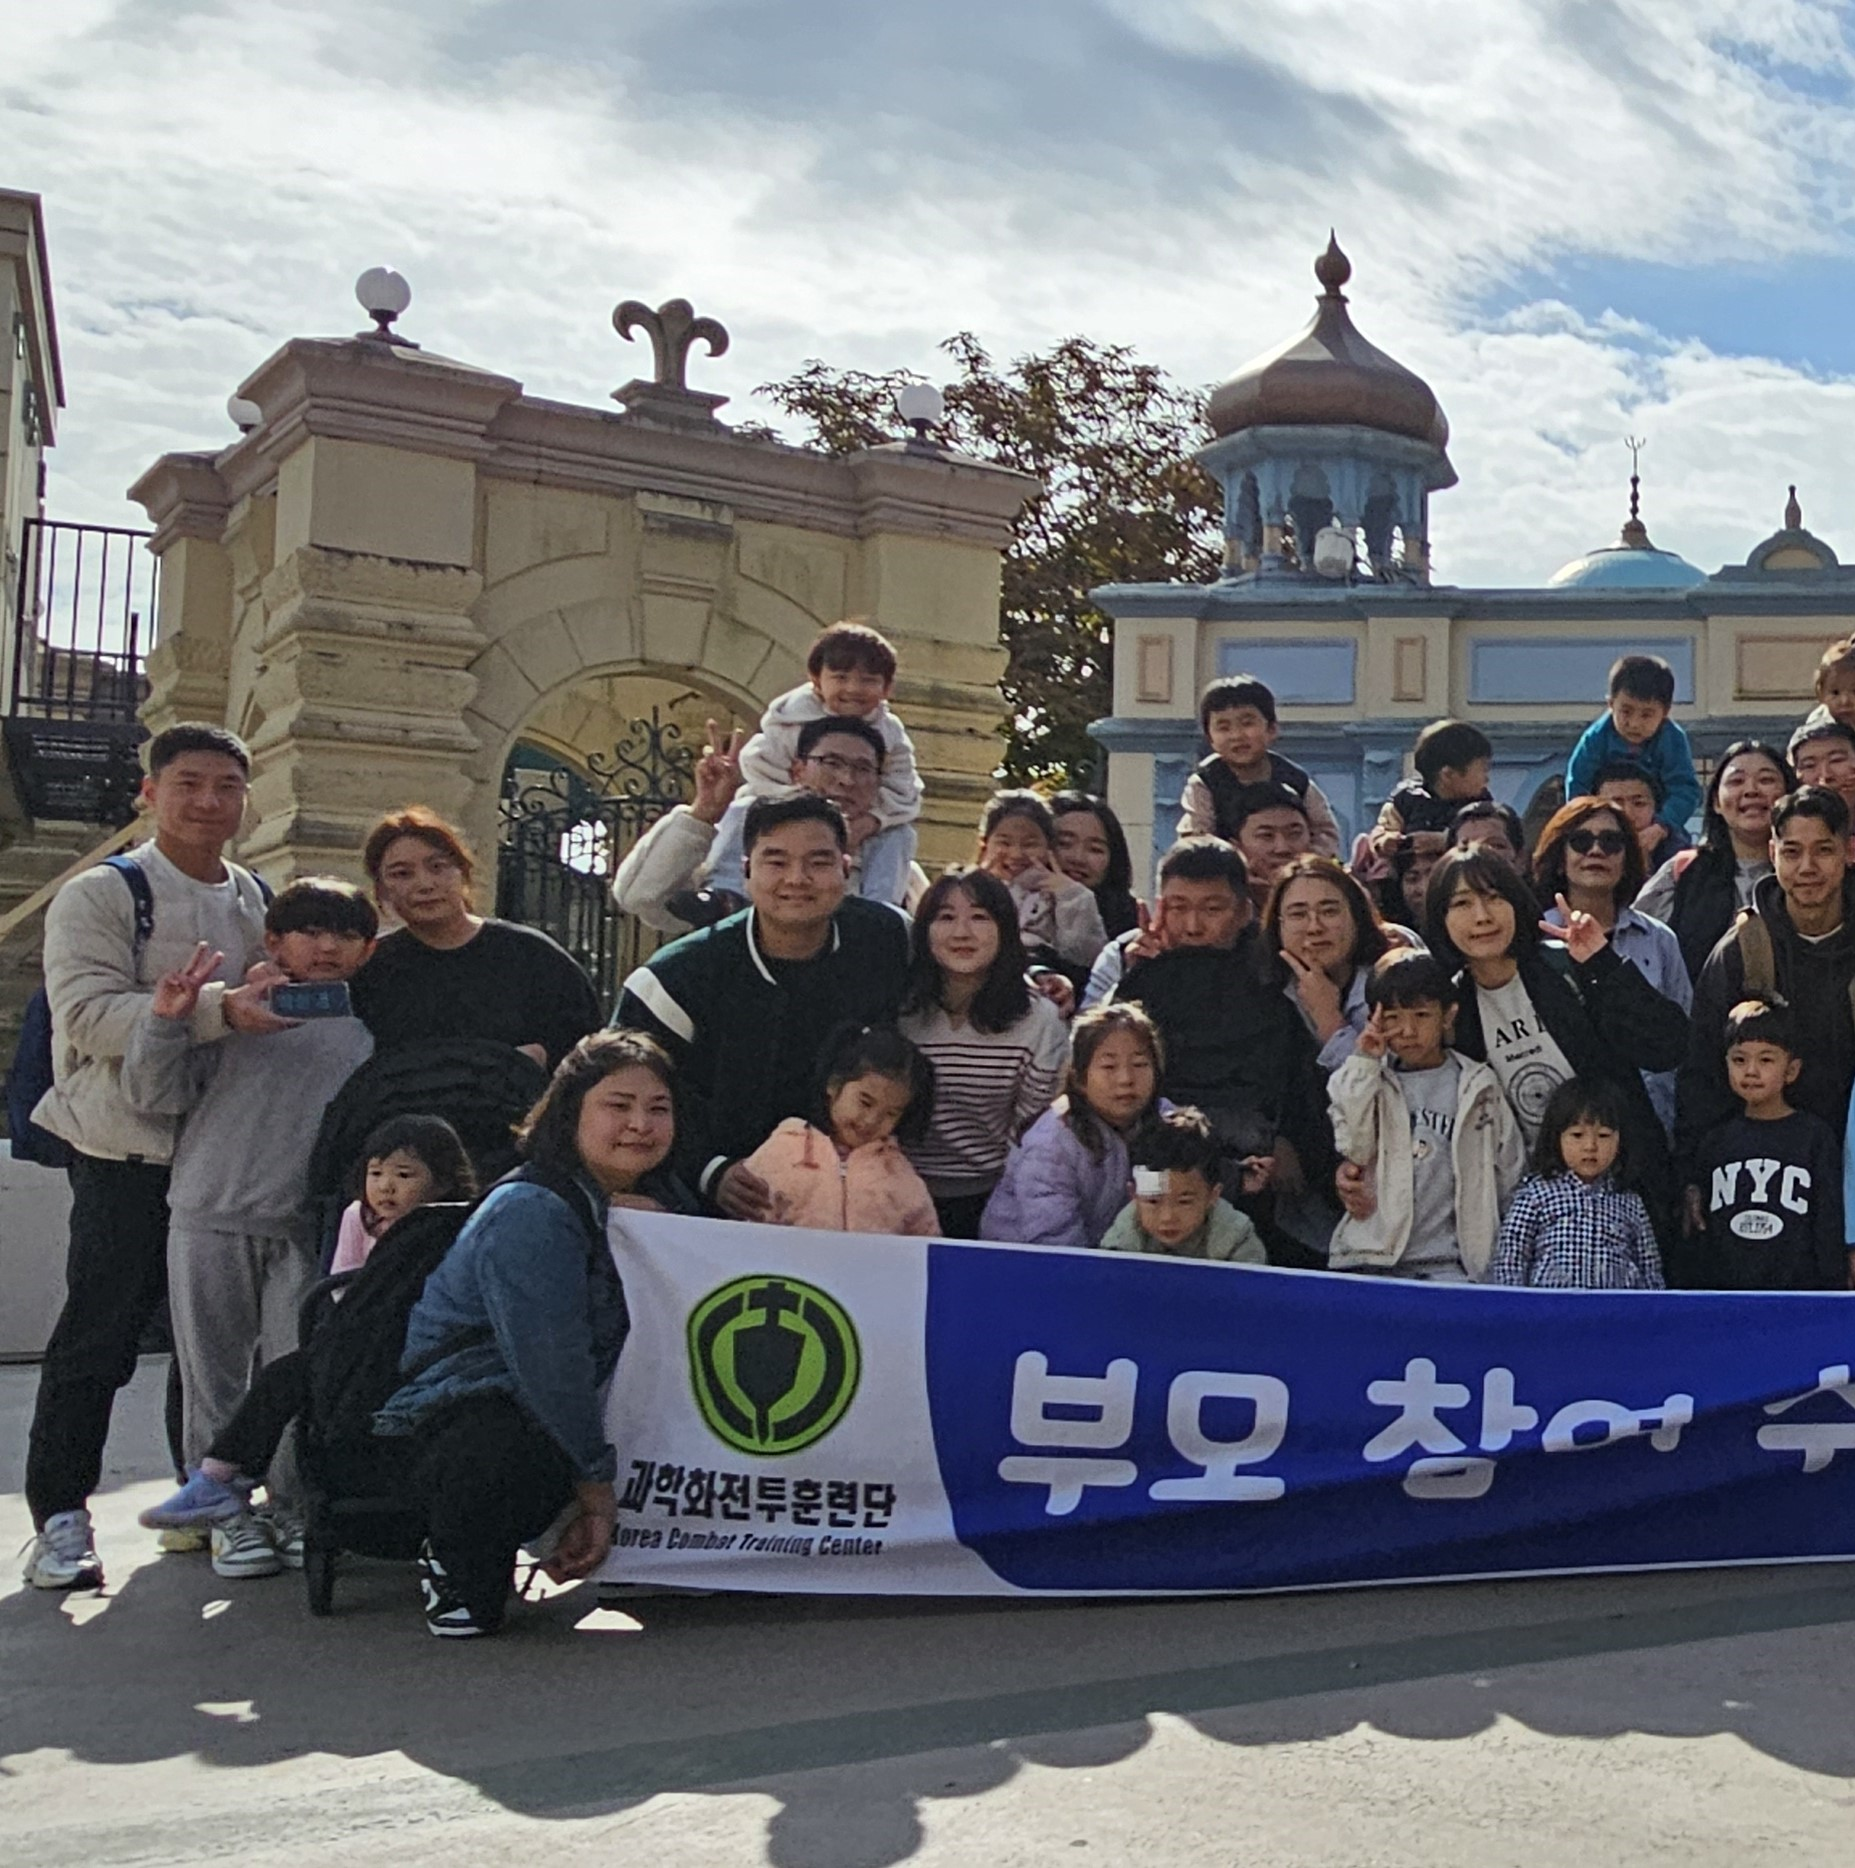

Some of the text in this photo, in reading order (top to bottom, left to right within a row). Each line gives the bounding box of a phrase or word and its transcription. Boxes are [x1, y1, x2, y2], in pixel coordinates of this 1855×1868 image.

[1710, 1158, 1812, 1215] NYC
[998, 1350, 1290, 1516] 부모
[617, 1459, 897, 1529] 과학화전투훈련단
[666, 1527, 738, 1552] Combat
[738, 1532, 815, 1557] Training
[818, 1534, 884, 1557] Center
